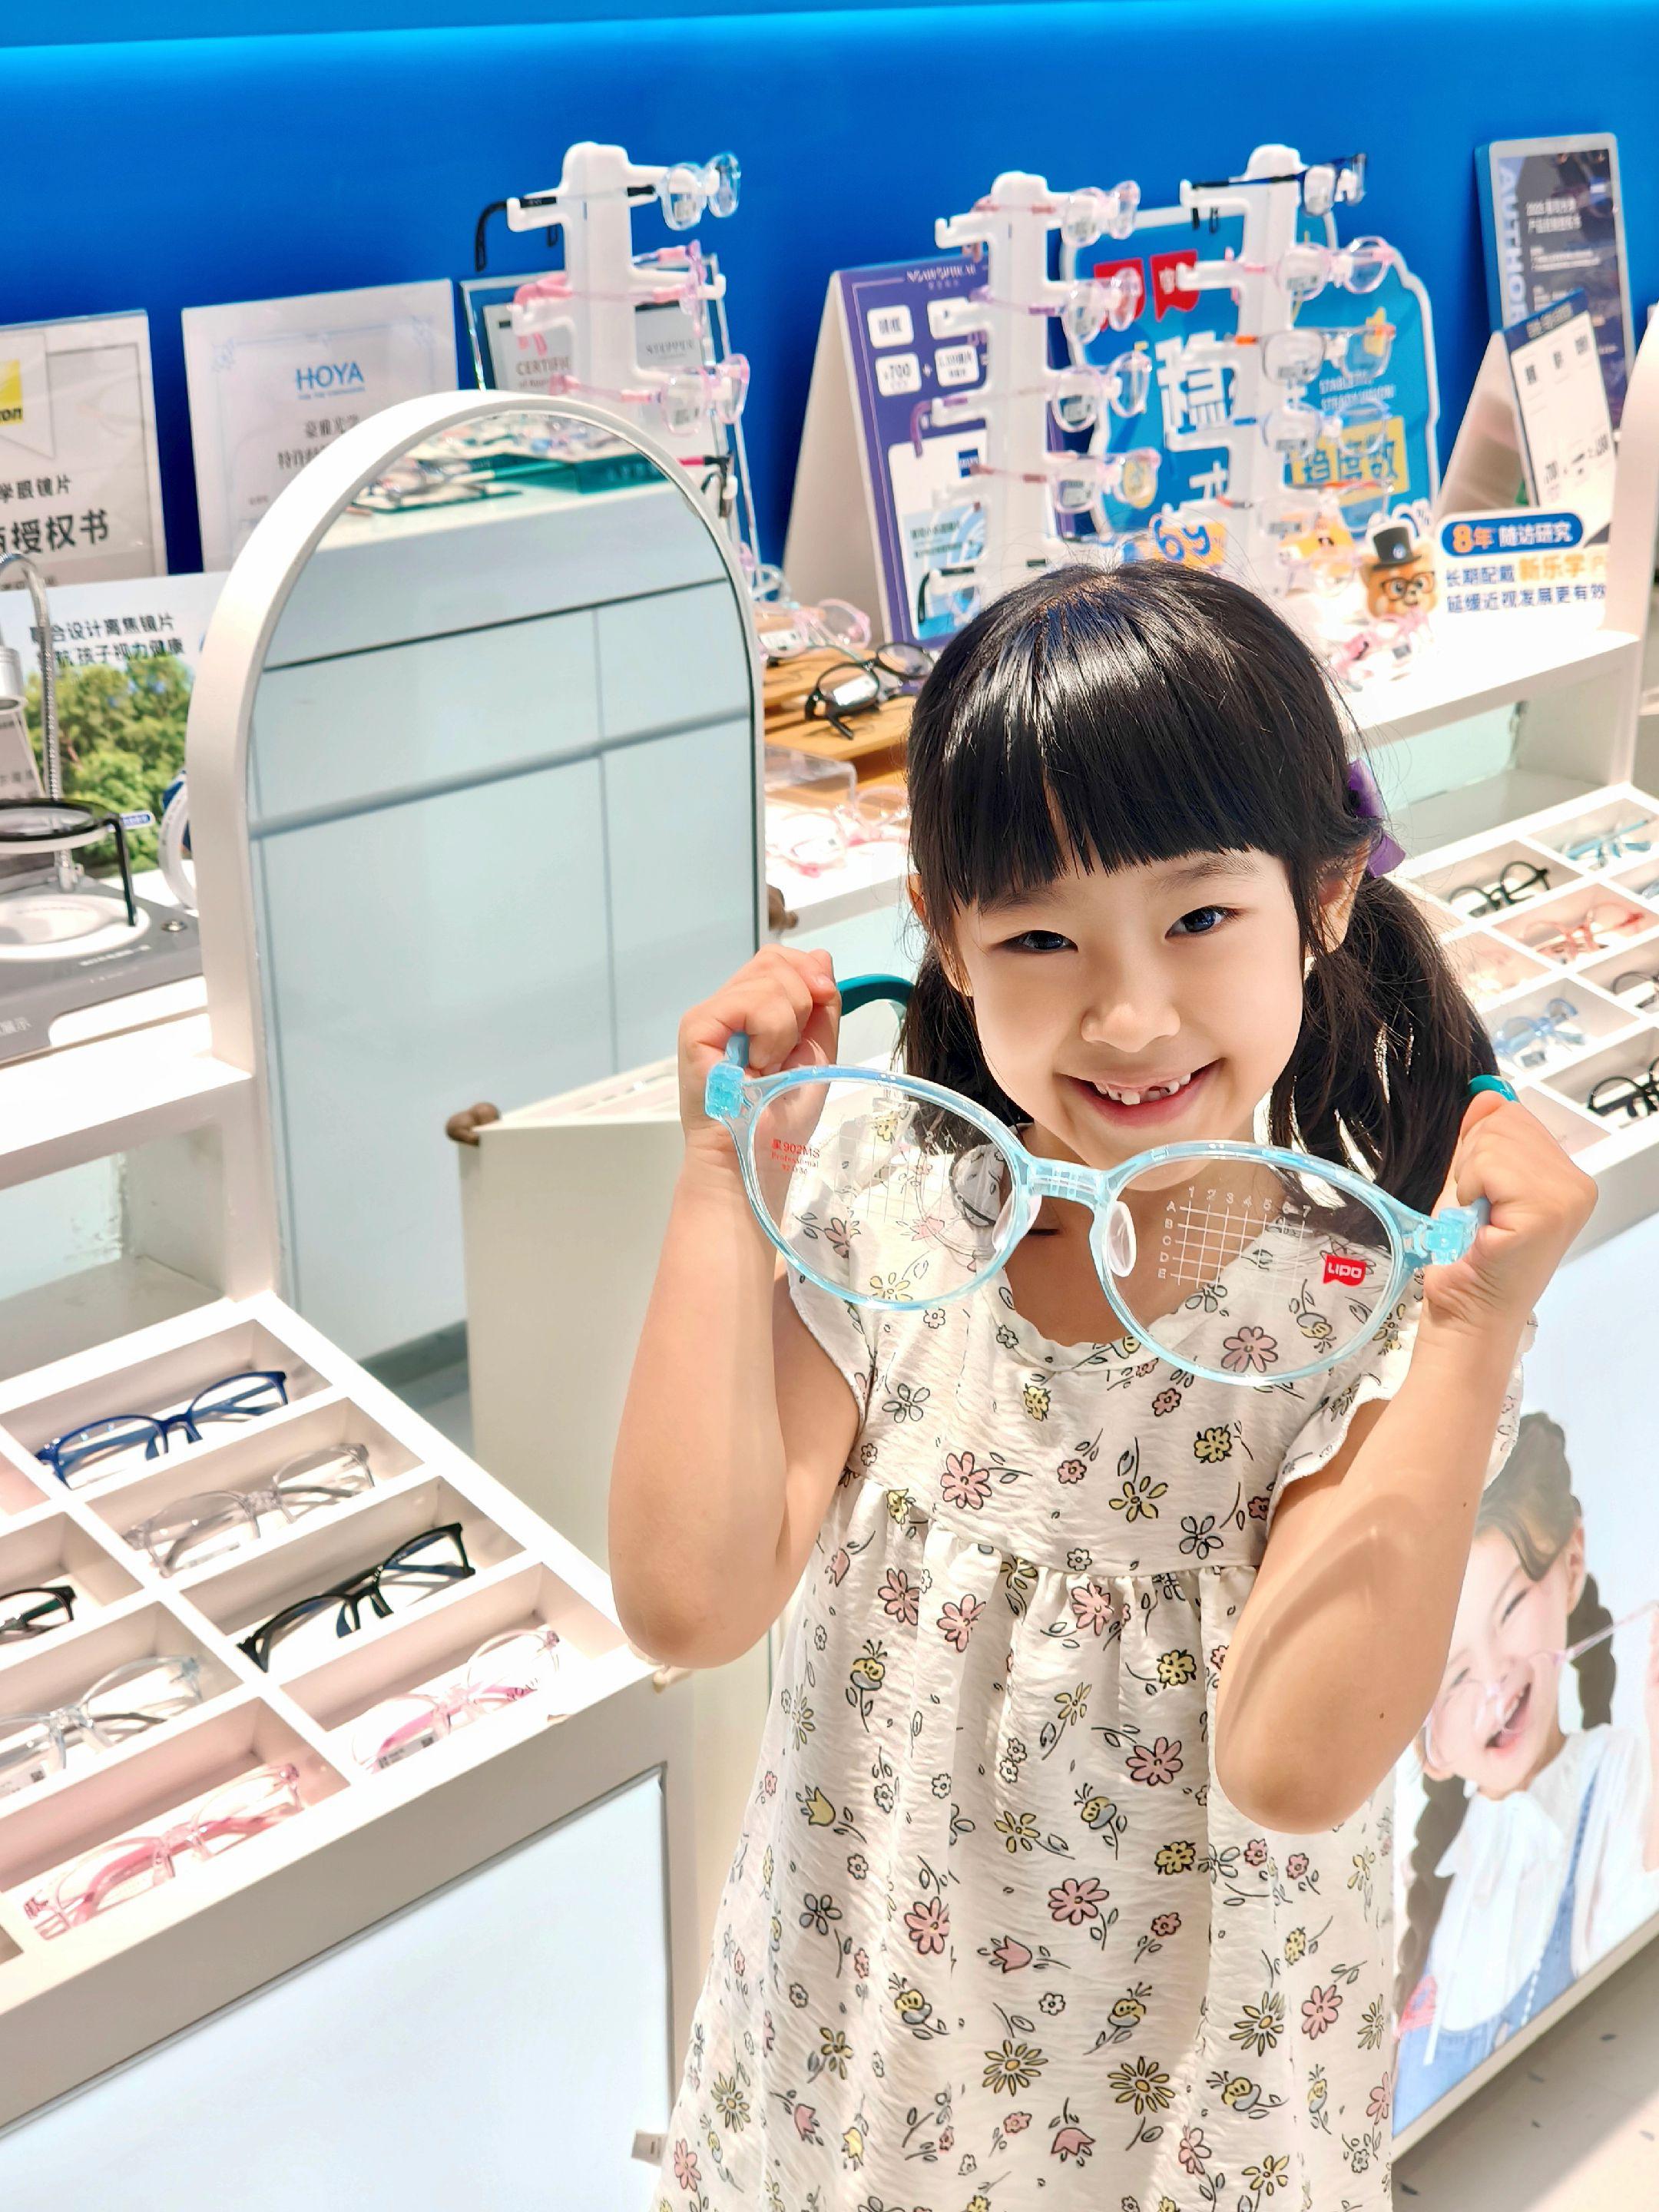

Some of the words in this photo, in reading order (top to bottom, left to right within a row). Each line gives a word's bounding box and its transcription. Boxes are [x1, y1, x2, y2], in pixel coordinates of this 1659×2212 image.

[296, 361, 364, 390] HOYA
[0, 407, 22, 422] on
[1452, 524, 1495, 553] 8年
[37, 637, 184, 666] 航孩子视力健康
[1167, 1200, 1176, 1213] A
[1226, 1192, 1234, 1204] 3
[1303, 1204, 1312, 1217] 7
[1164, 1218, 1174, 1229] B
[1162, 1235, 1172, 1246] C
[1160, 1251, 1169, 1263] D
[1157, 1268, 1167, 1279] E
